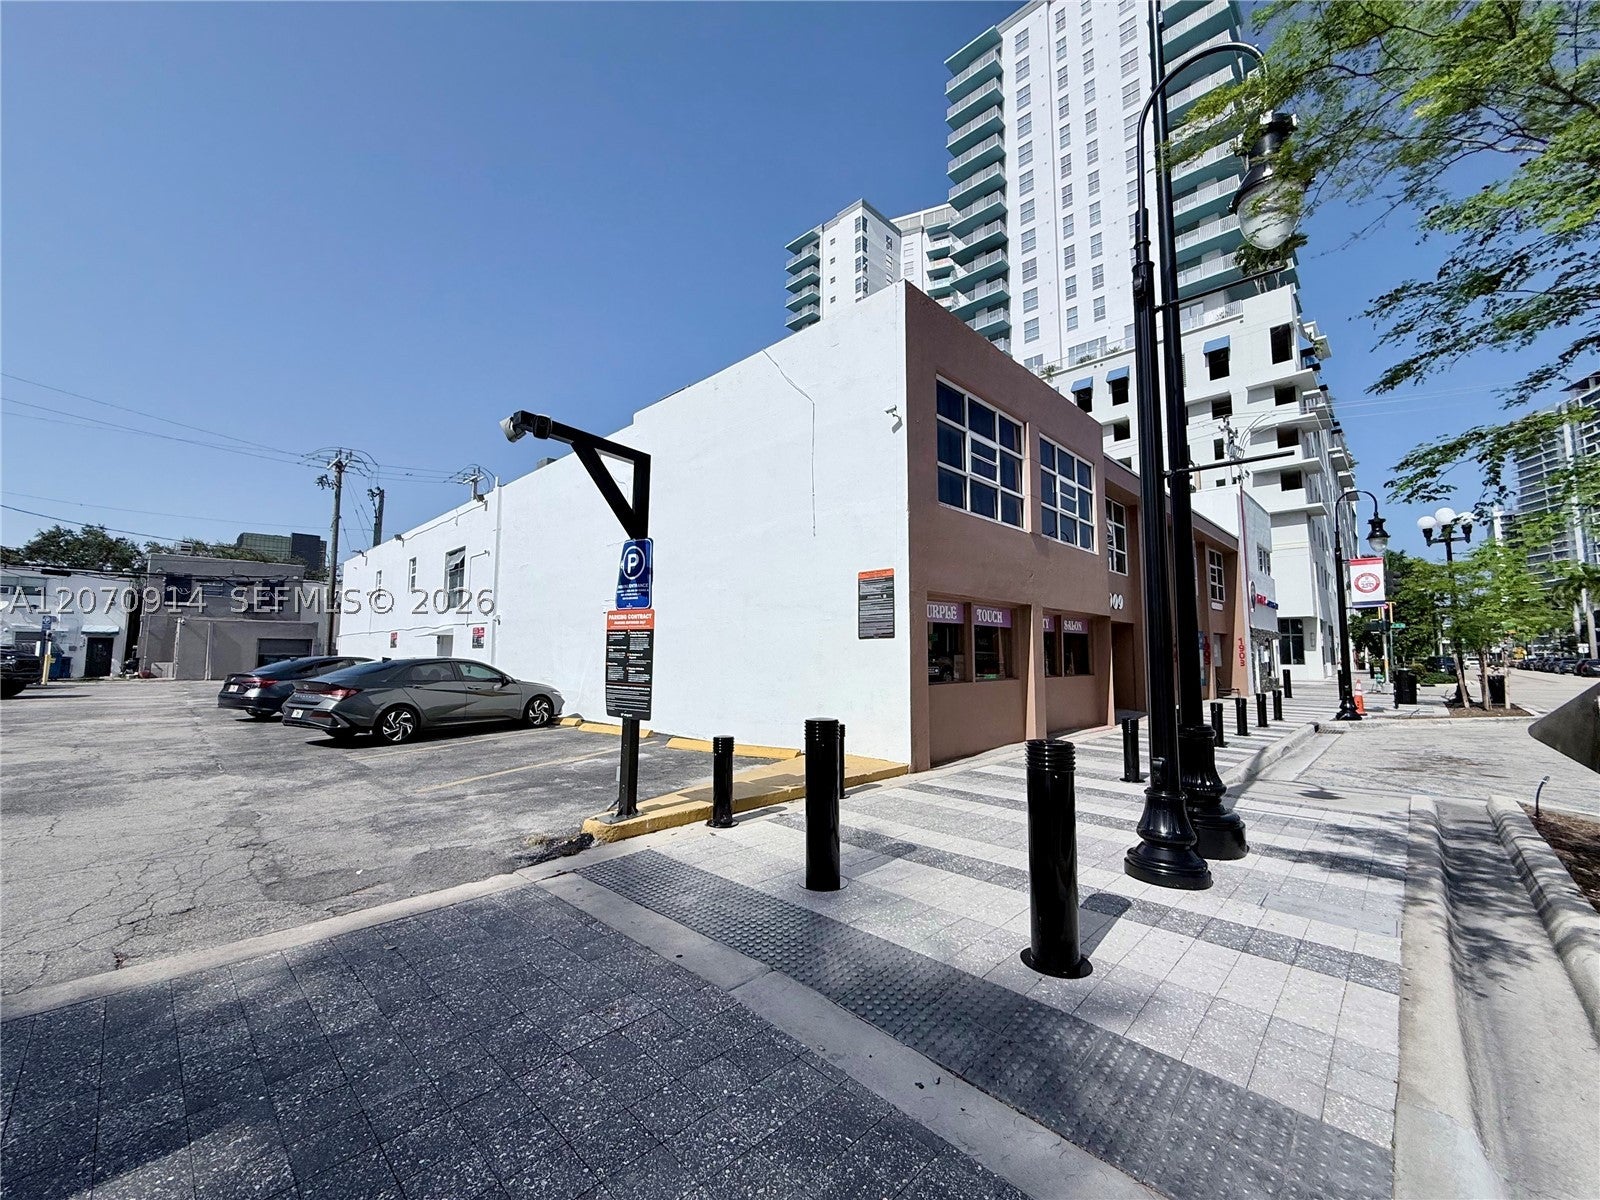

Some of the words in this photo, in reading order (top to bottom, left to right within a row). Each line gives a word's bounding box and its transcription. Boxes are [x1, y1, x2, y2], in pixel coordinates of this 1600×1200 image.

[627, 553, 640, 574] P
[976, 608, 1003, 624] TOUCH
[1063, 620, 1083, 631] SALON
